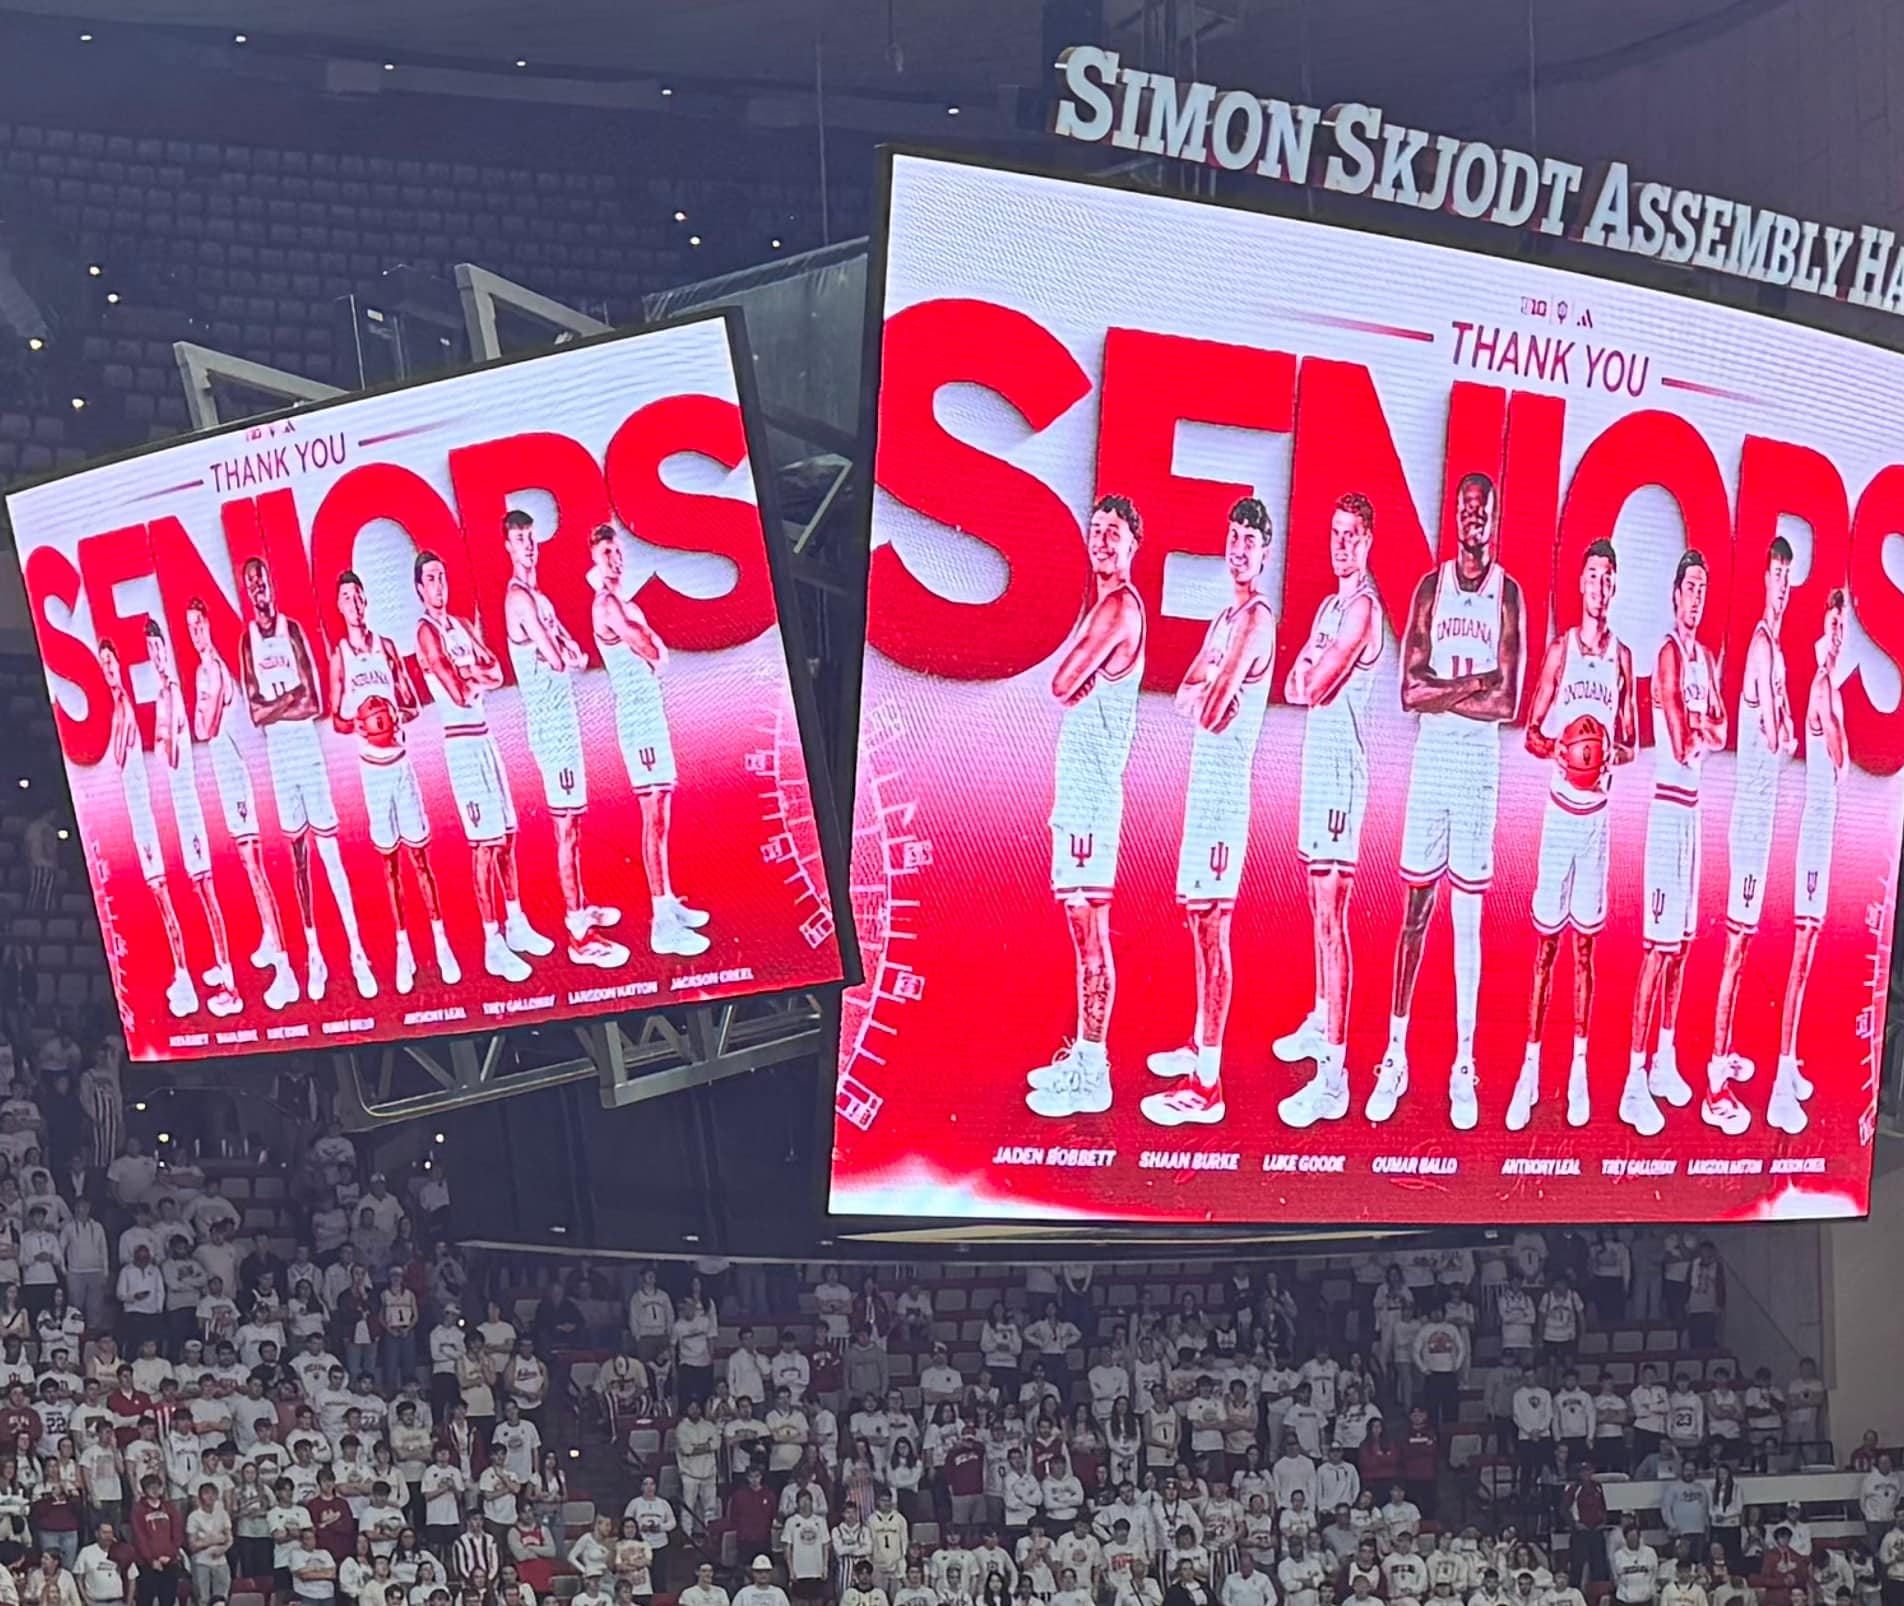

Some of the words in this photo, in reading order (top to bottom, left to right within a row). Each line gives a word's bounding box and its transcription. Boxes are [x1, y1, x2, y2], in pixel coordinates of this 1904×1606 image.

[1055, 44, 1321, 188] SIMON
[1322, 100, 1582, 237] SKJODT
[1583, 159, 1854, 299] ASSEMBLY
[1449, 318, 1576, 388] THANK
[1577, 342, 1652, 399] YOU
[209, 441, 294, 495] THANK
[295, 431, 347, 473] YOU
[24, 393, 780, 768] SENIORS
[1436, 618, 1494, 647] INDIANA
[993, 1147, 1044, 1166] JADEN
